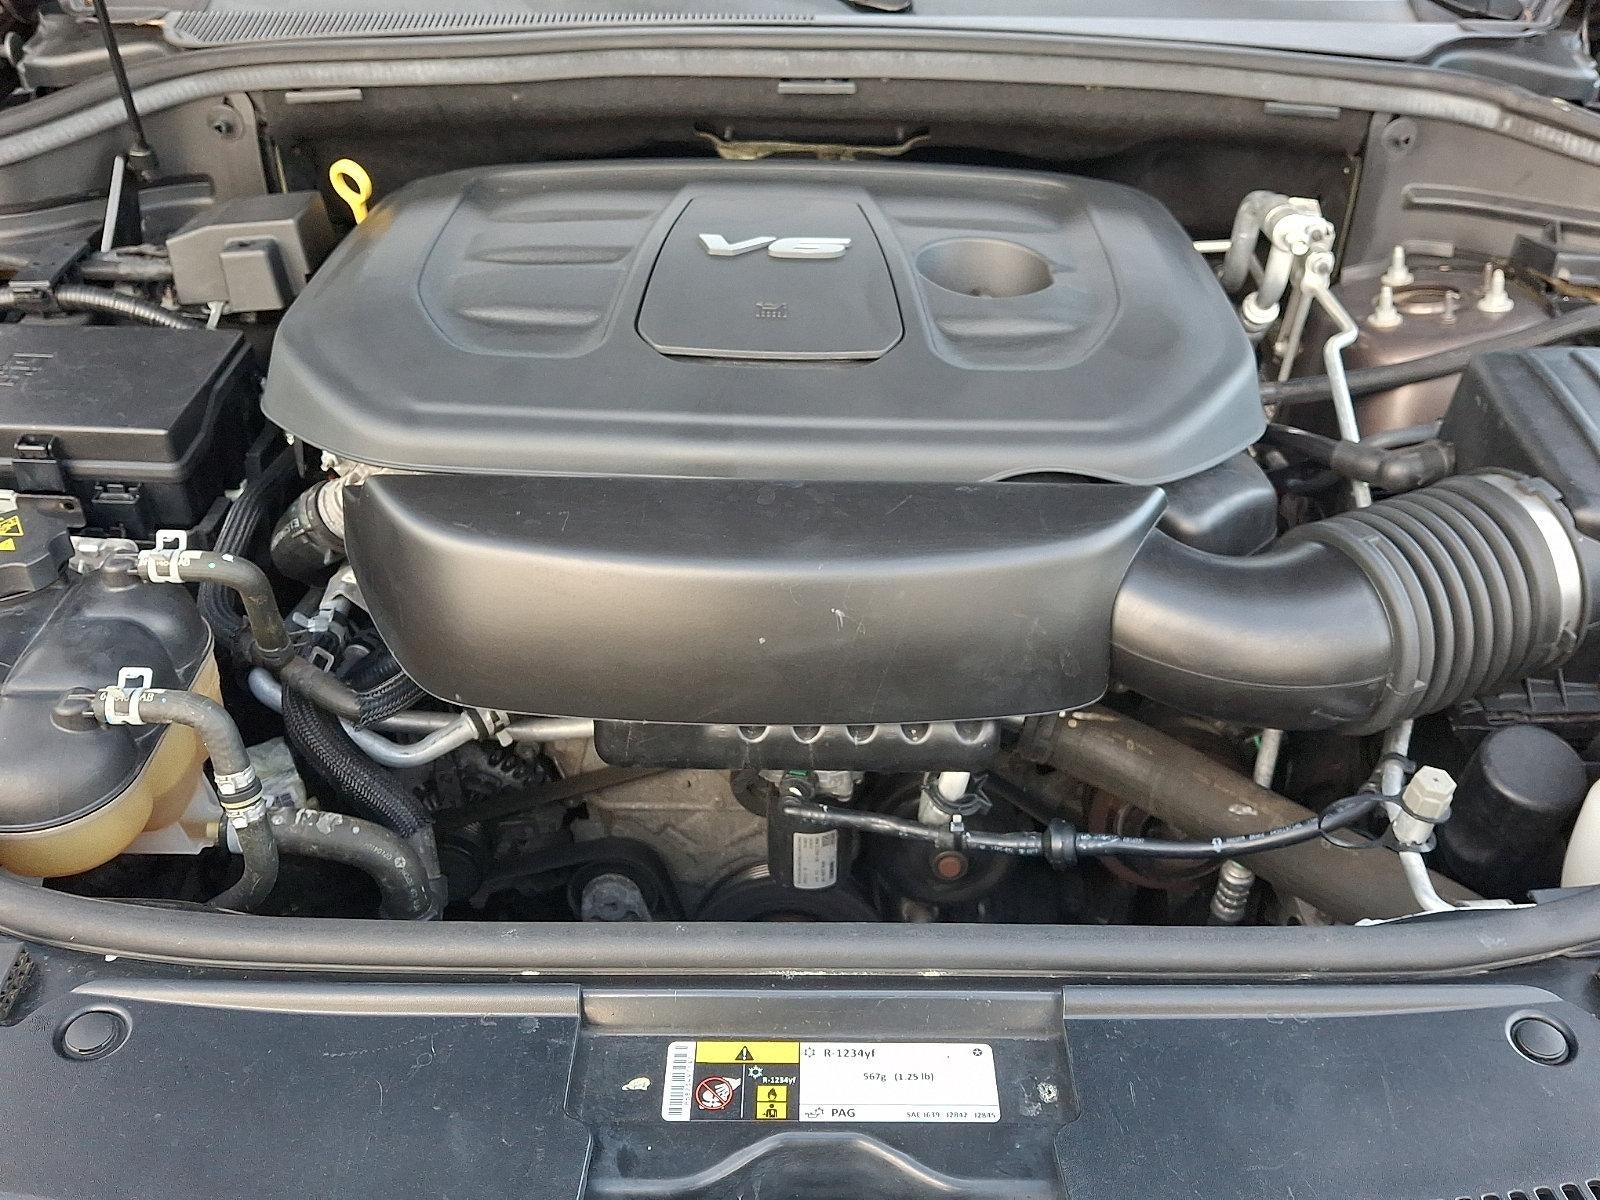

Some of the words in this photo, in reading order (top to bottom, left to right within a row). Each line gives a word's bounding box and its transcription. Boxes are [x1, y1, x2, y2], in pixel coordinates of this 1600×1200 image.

[699, 233, 851, 259] V6
[823, 1048, 876, 1059] R-1234yf
[863, 1072, 887, 1082] 567g
[894, 1072, 919, 1082] (1.25
[921, 1072, 935, 1082] lb)
[831, 1108, 856, 1118] PAG
[906, 1111, 920, 1119] SAE
